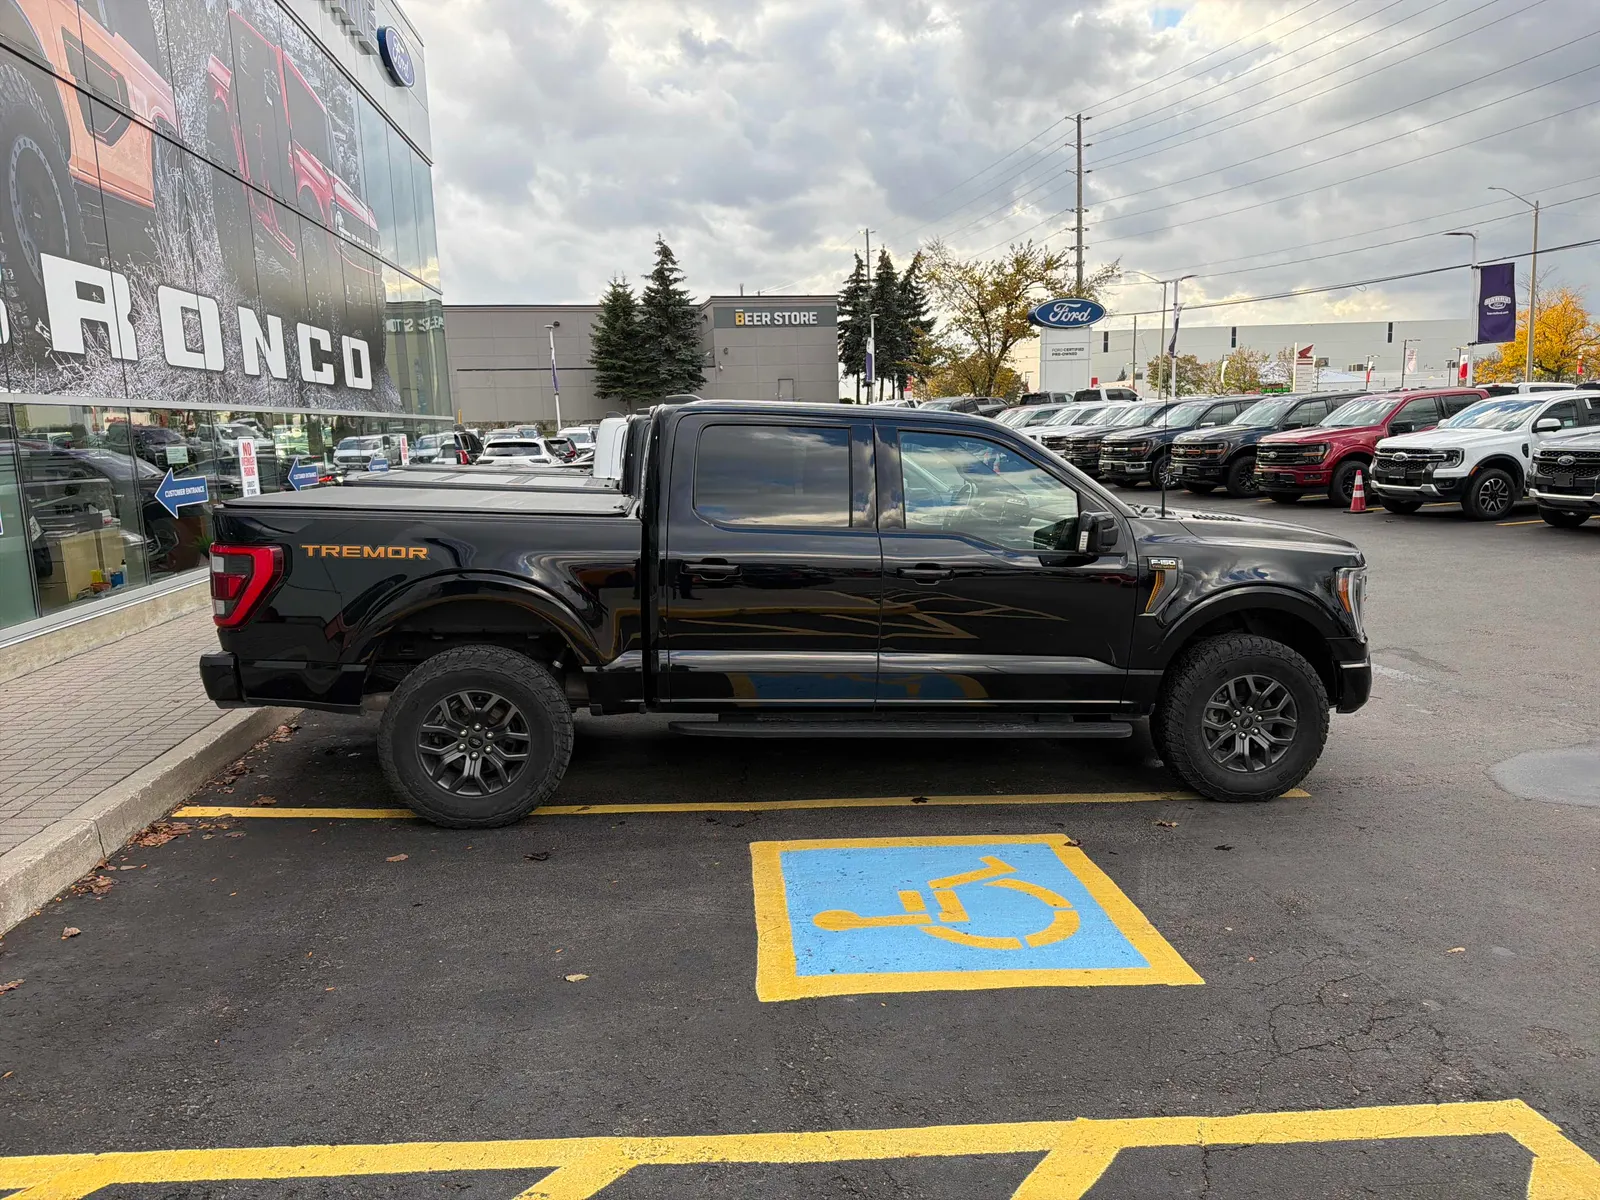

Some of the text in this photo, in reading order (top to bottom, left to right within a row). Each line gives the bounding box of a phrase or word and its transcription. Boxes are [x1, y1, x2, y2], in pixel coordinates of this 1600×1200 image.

[735, 309, 818, 326] BEER STORE
[1049, 303, 1092, 322] Ford
[0, 252, 372, 390] RONCO
[242, 442, 252, 456] NO
[164, 485, 205, 498] CUSTOMER ENTRANCE
[301, 544, 429, 560] TREMOR
